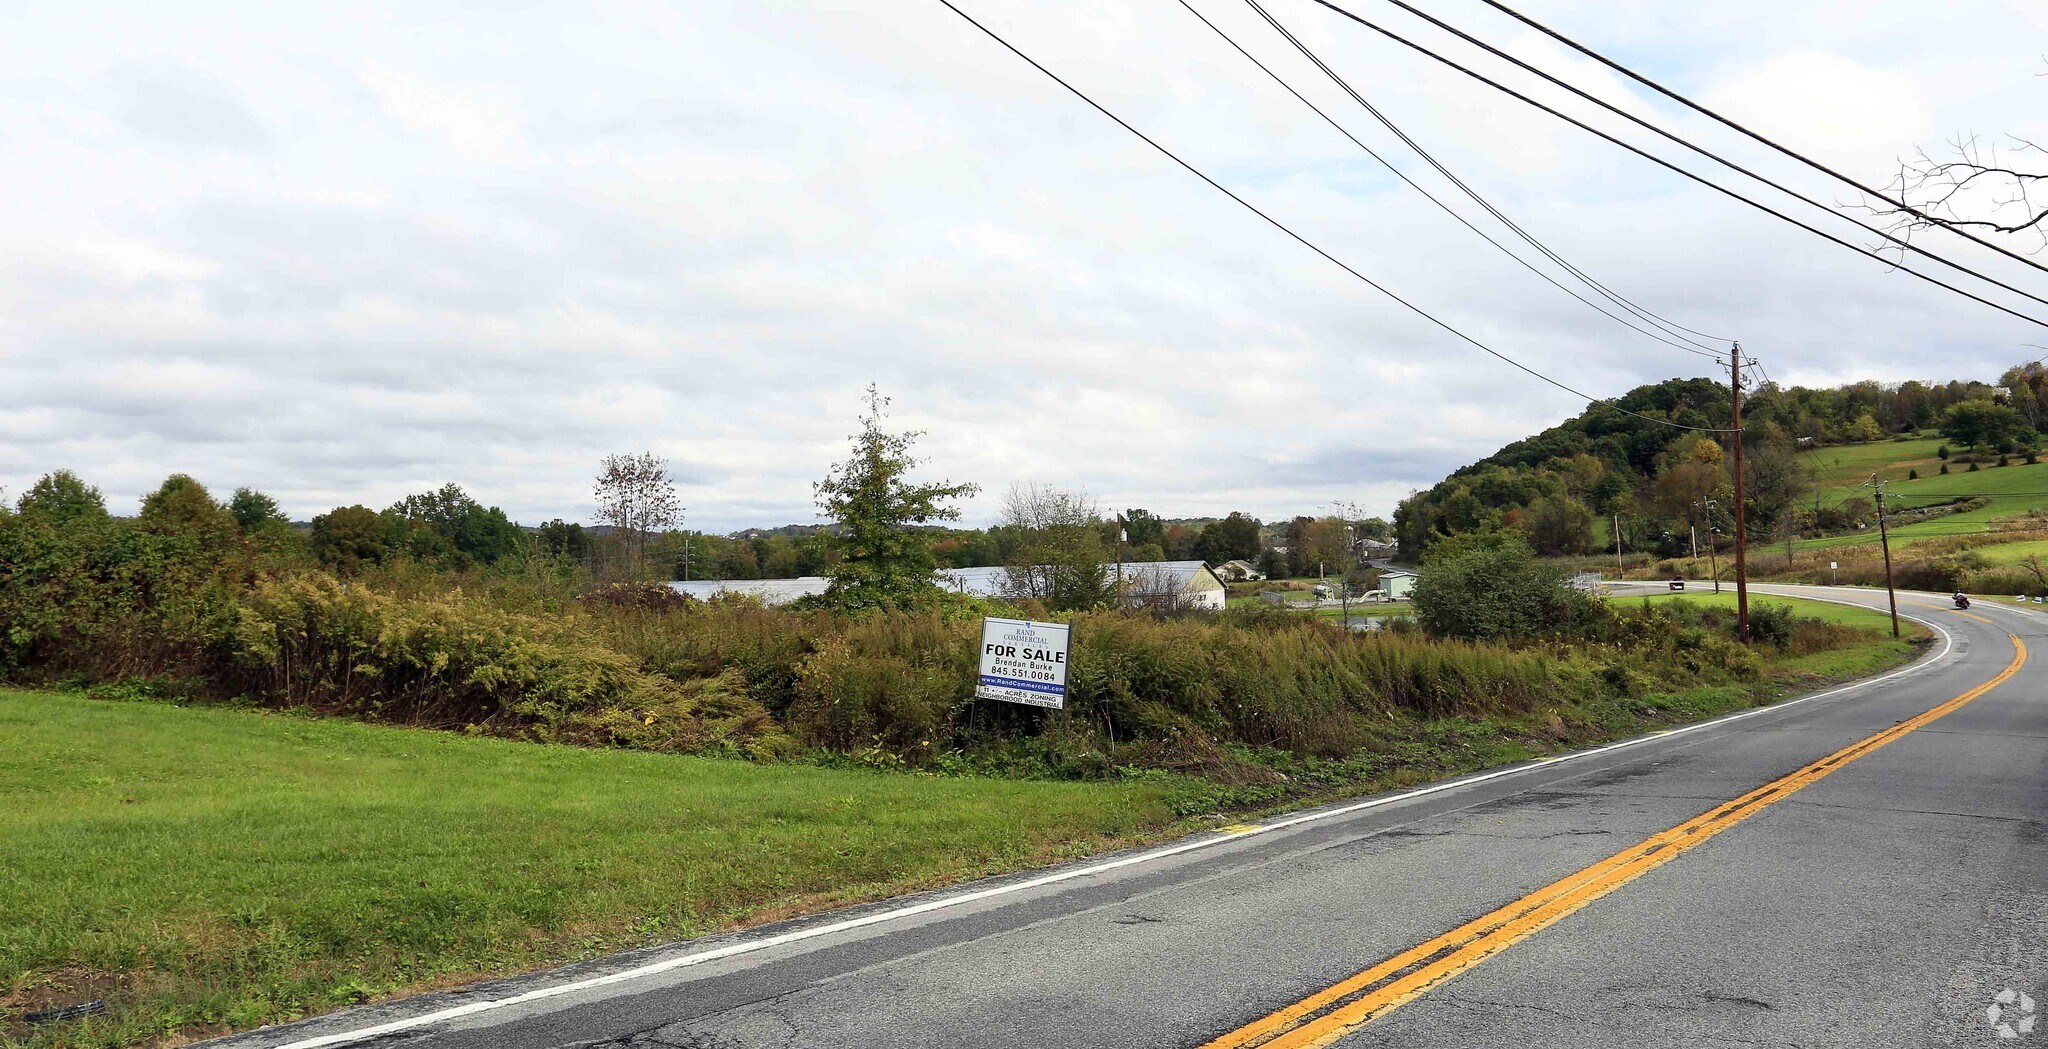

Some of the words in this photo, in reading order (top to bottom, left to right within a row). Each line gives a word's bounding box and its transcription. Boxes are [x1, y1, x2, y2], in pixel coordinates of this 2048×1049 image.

[1004, 634, 1048, 644] COMMERCIAL
[986, 644, 1016, 658] FOR
[1022, 648, 1065, 663] SALE
[996, 658, 1026, 668] Brendan
[1030, 662, 1053, 671] Burke
[992, 666, 1056, 681] 845.551.0084
[981, 678, 1064, 692] www.RandCommercial.com
[1004, 690, 1028, 698] ACRES
[1030, 694, 1056, 702] ZONING
[1024, 698, 1061, 708] INDUSTRIAL
